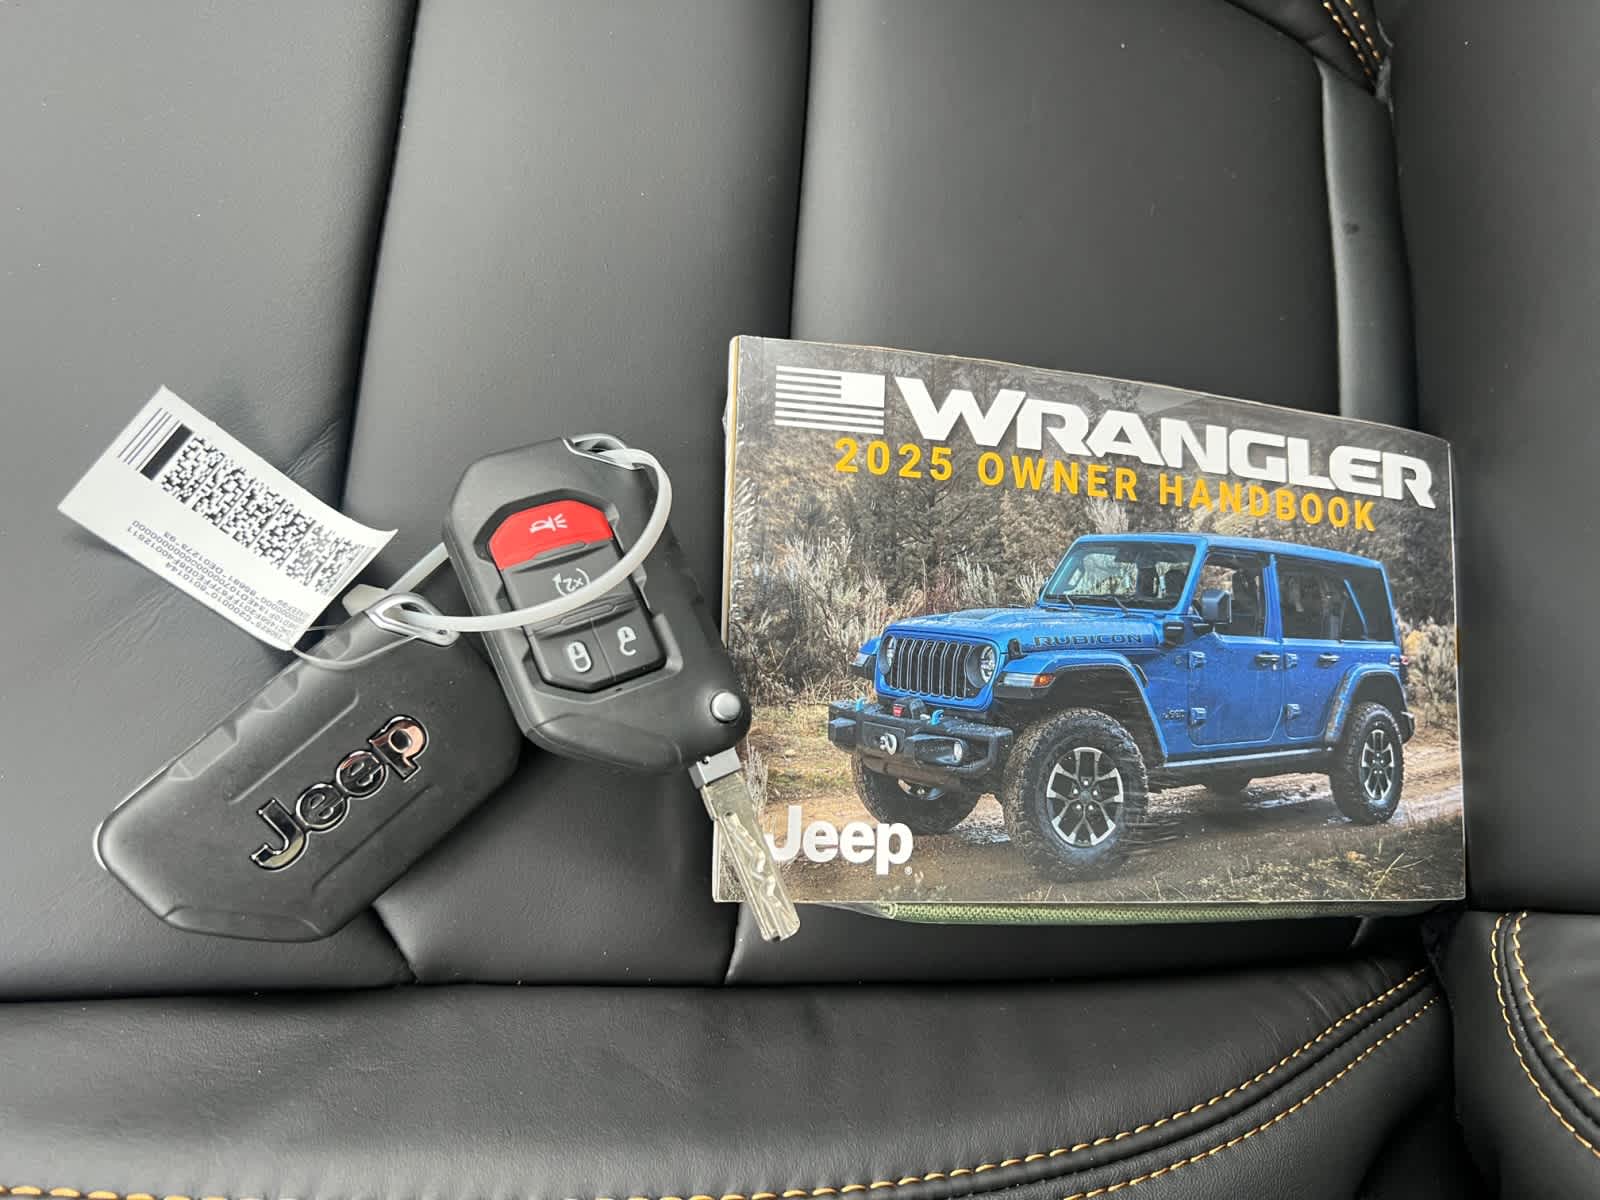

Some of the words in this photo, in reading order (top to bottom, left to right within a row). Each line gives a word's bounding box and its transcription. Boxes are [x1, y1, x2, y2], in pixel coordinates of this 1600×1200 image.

[835, 438, 953, 481] 2025
[978, 451, 1137, 501] OWNER
[1159, 473, 1376, 532] HANDBOOK
[895, 376, 1436, 509] WRANGLER
[1034, 634, 1143, 647] RUBICON
[249, 714, 431, 873] Jeep
[763, 805, 914, 875] Jeep
